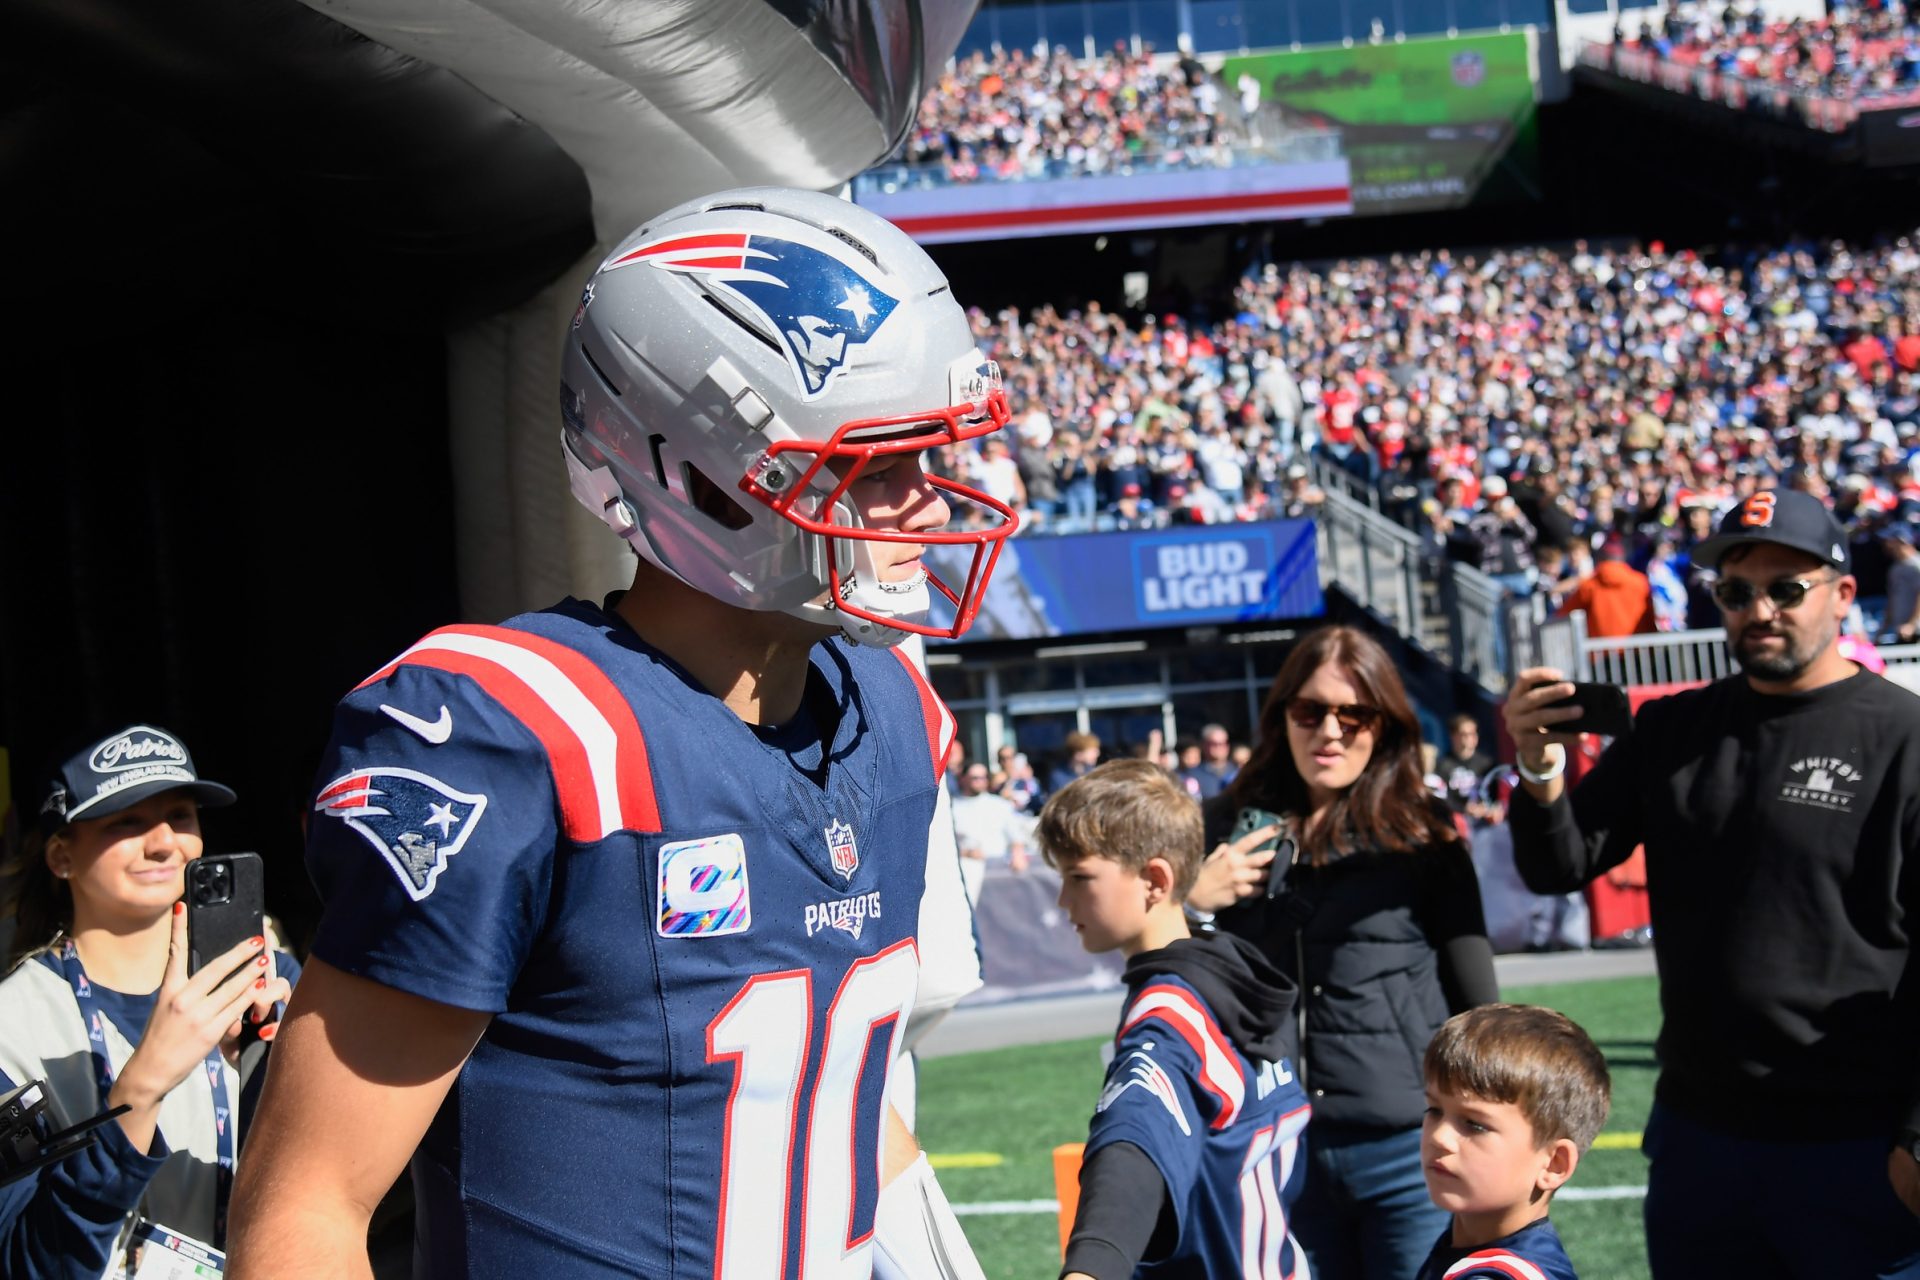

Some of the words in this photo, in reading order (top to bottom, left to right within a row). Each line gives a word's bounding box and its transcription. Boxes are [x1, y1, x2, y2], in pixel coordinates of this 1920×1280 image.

[1741, 491, 1777, 528] S
[1157, 541, 1248, 578] BUD
[1143, 570, 1267, 612] LIGHT
[1790, 756, 1863, 782] WHITBY
[834, 845, 857, 869] NFL
[665, 843, 741, 912] C
[804, 891, 881, 938] PATRIOTS
[704, 936, 921, 1280] 10
